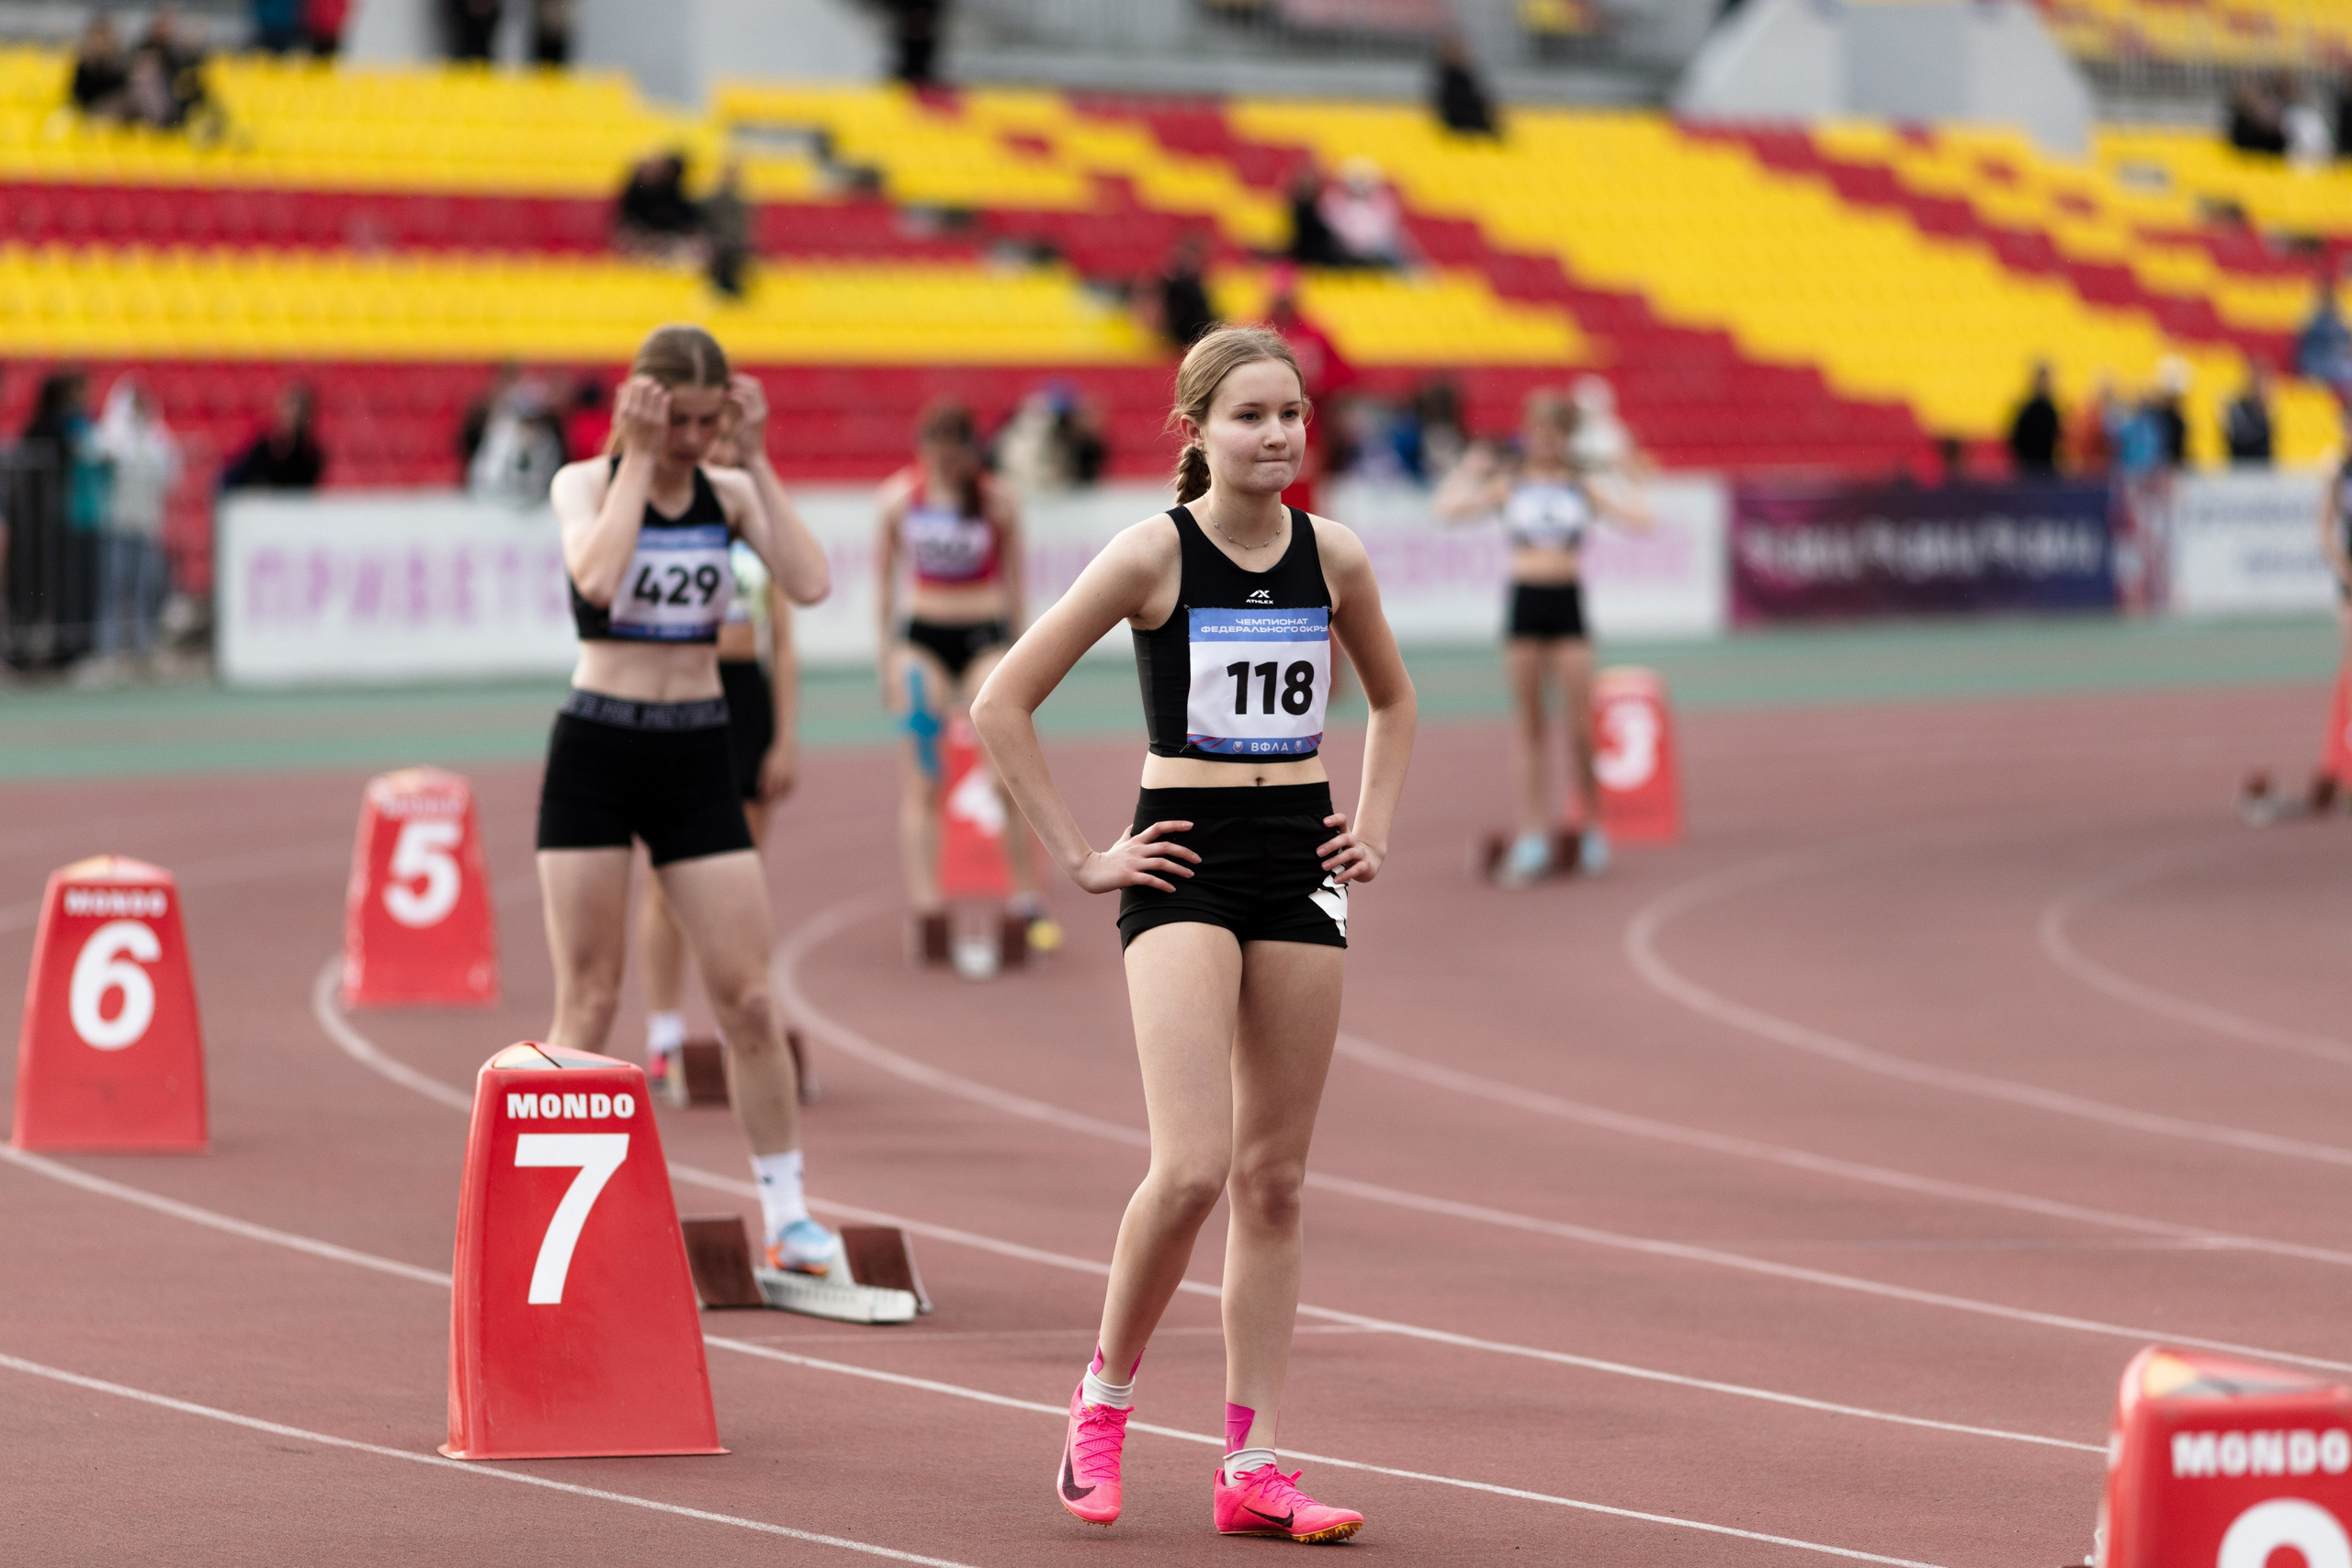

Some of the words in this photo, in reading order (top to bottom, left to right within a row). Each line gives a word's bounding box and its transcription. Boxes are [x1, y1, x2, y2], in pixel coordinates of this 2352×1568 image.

[633, 564, 721, 606] 429
[1200, 626, 1299, 634] ФЕДЕРАЛЬНОГО
[1227, 660, 1315, 716] 118
[1250, 741, 1289, 751] ВФЛА
[380, 819, 464, 929] 5
[64, 889, 167, 918] MONDO
[68, 919, 163, 1052] 6
[507, 1093, 635, 1120] MONDO
[514, 1133, 630, 1305] 7
[2171, 1428, 2351, 1479] MONDO
